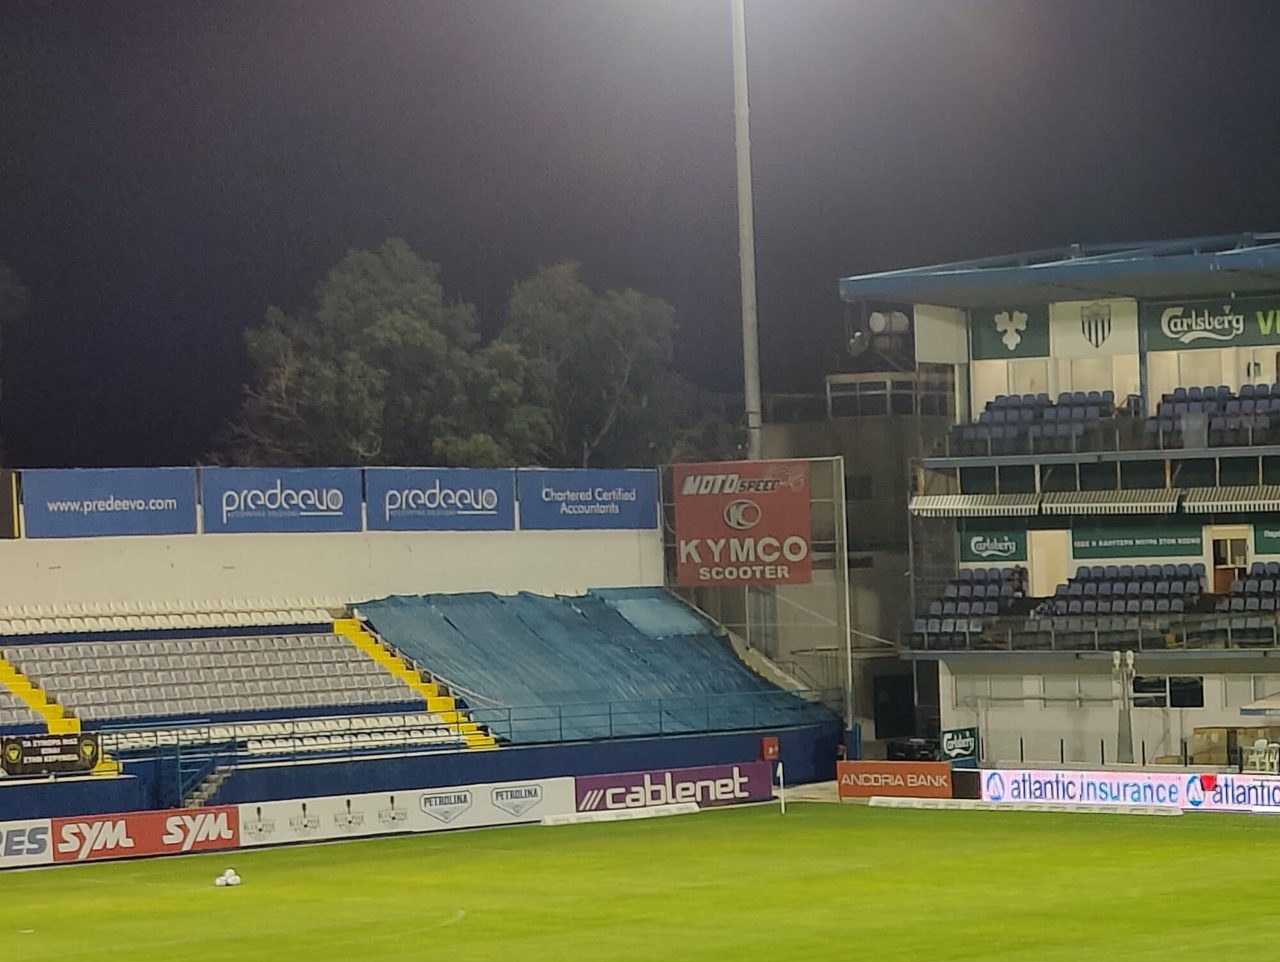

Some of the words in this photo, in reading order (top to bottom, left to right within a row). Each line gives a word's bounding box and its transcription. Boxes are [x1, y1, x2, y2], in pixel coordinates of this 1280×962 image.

[1161, 306, 1244, 341] Carlsberg
[47, 495, 177, 516] www.predeevo.com
[222, 479, 344, 524] predeevo
[386, 479, 498, 522] predeevo
[542, 488, 592, 501] Chartered
[595, 488, 636, 501] Certified
[560, 502, 619, 514] Accountants
[679, 536, 808, 563] KYMCO
[970, 535, 1017, 557] Carlsberg
[700, 565, 790, 580] SCOOTER
[606, 767, 749, 809] cablenet
[841, 773, 905, 787] ANCORIA
[908, 775, 949, 788] BANK
[1010, 773, 1077, 800] atlantic
[1080, 775, 1178, 803] insurance
[424, 794, 468, 807] PETROLINA
[495, 788, 539, 801] PETROLINA
[0, 826, 49, 857] ES
[57, 820, 135, 860] SYM
[162, 812, 233, 851] SYM
